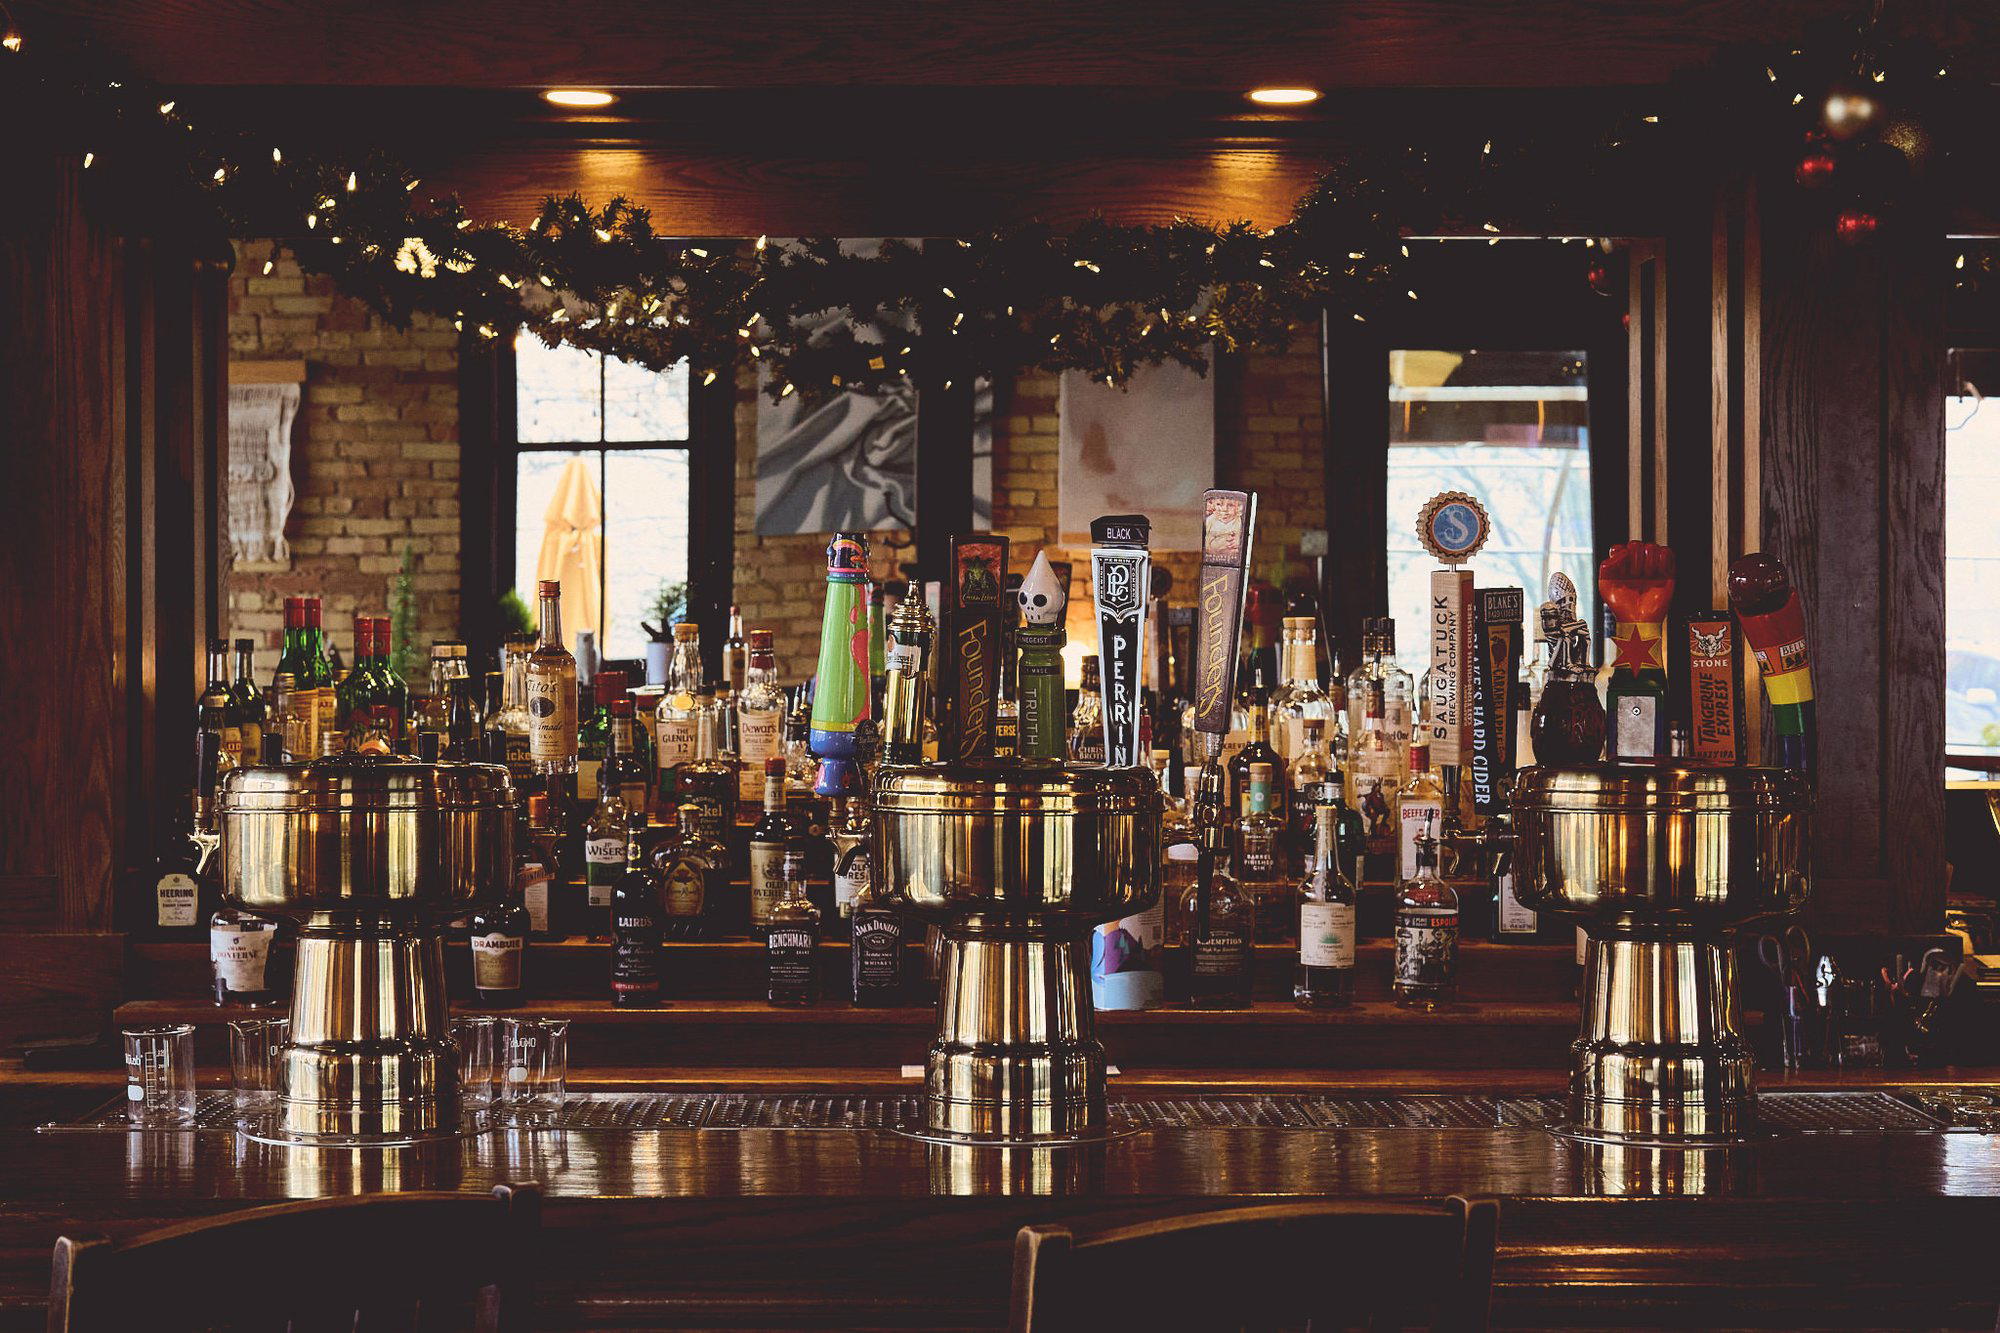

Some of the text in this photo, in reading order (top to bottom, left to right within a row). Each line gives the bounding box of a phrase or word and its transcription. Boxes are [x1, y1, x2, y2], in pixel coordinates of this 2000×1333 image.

[1106, 527, 1131, 540] BLACK
[1488, 594, 1518, 609] BLAKE'S
[1199, 574, 1229, 718] Founders
[1433, 596, 1448, 740] SAUGATUCK
[1692, 659, 1729, 668] STONE
[527, 679, 559, 693] Tito's
[958, 618, 991, 759] Founders
[1110, 633, 1132, 767] PERRIN
[1697, 672, 1720, 746] TANGERINE
[1715, 679, 1731, 737] EXPRESS
[1024, 688, 1039, 746] TRUTH
[676, 727, 689, 735] THE
[742, 722, 777, 734] Dewar's
[1473, 706, 1486, 750] HARD
[662, 734, 694, 744] GLENLIV
[506, 748, 532, 761] icke
[677, 743, 689, 753] 12
[1078, 746, 1103, 754] CHRIS
[1474, 755, 1490, 805] CIDER
[1402, 808, 1440, 820] BEEFEAER
[160, 888, 195, 898] HEERING
[618, 914, 653, 927] LAIRD'S
[855, 923, 874, 937] JACK
[473, 940, 520, 949] DRAMBUIE
[769, 933, 813, 949] BENCHMARK
